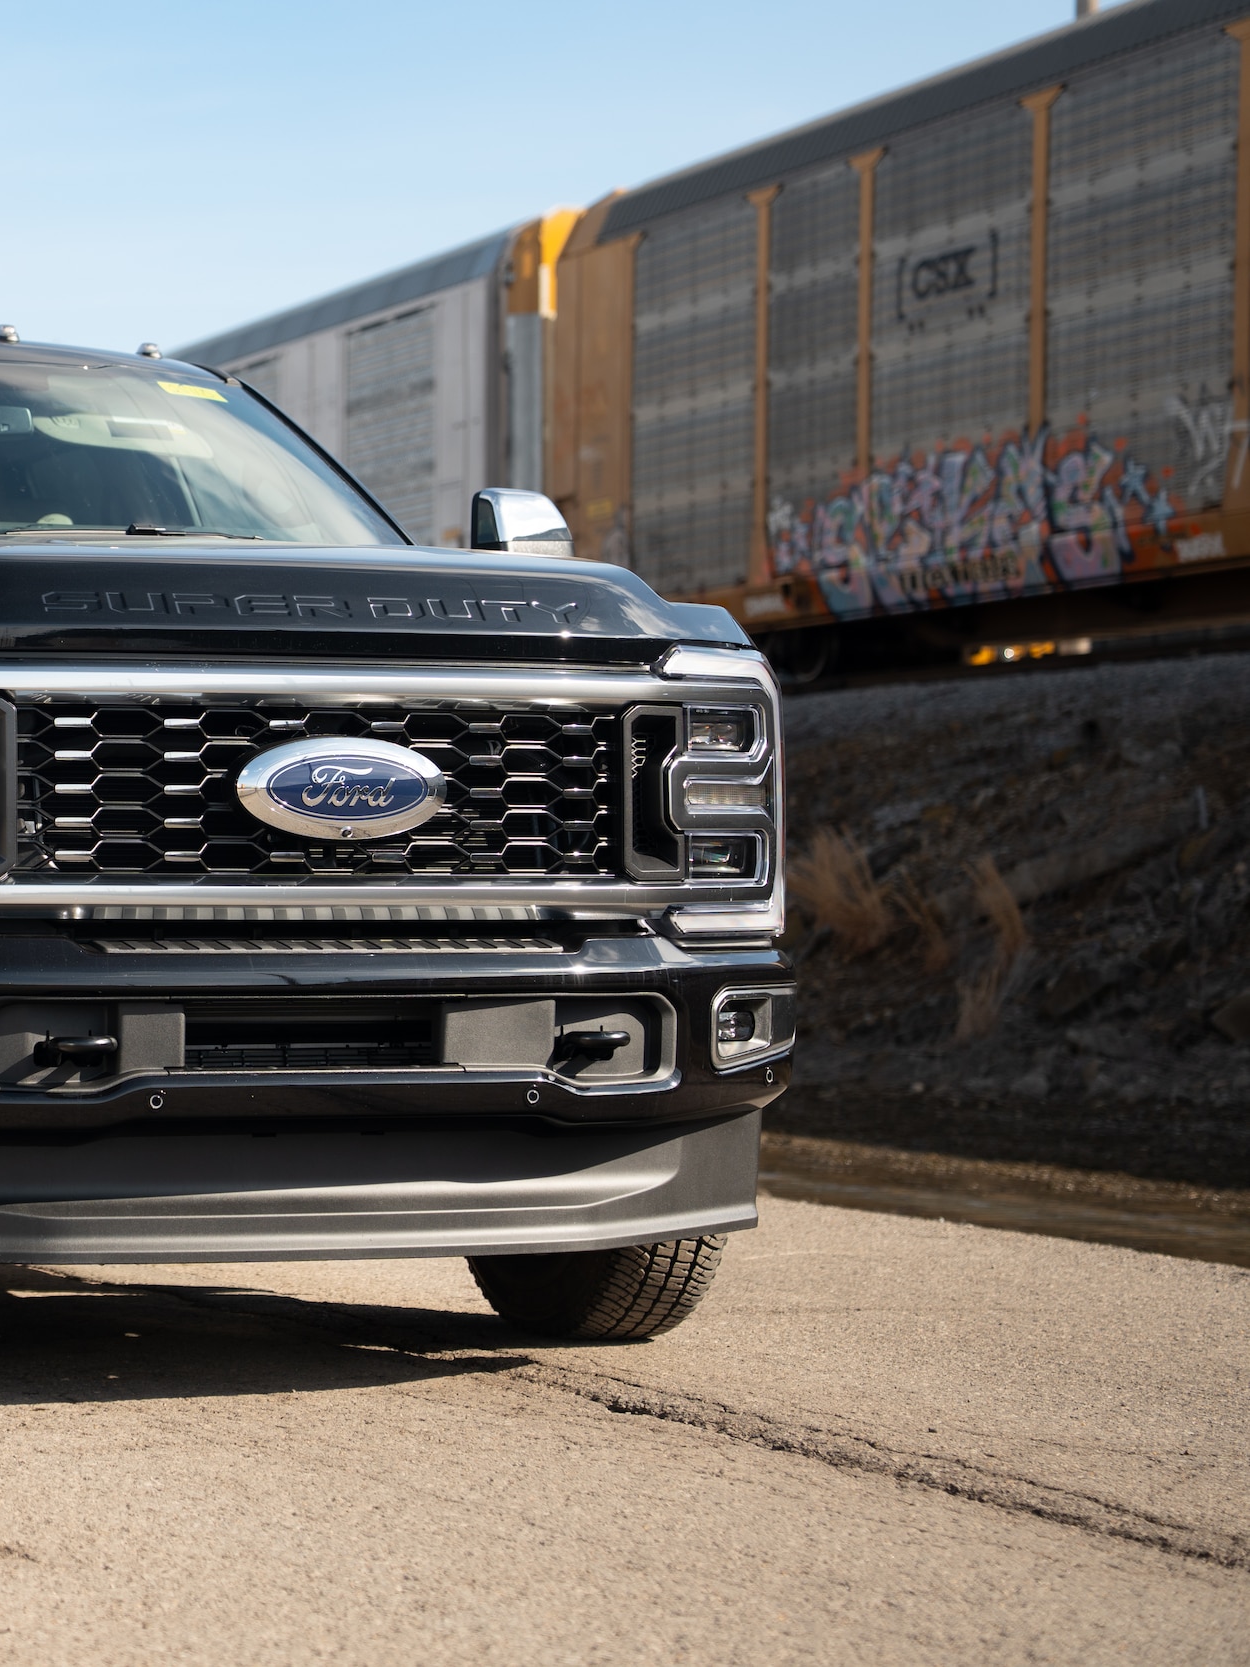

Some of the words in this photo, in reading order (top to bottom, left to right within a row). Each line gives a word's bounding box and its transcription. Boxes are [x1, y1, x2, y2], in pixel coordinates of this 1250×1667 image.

[913, 246, 976, 298] CSX
[41, 591, 352, 618] SUPER
[367, 597, 579, 624] DUTY
[302, 765, 397, 807] Ford
